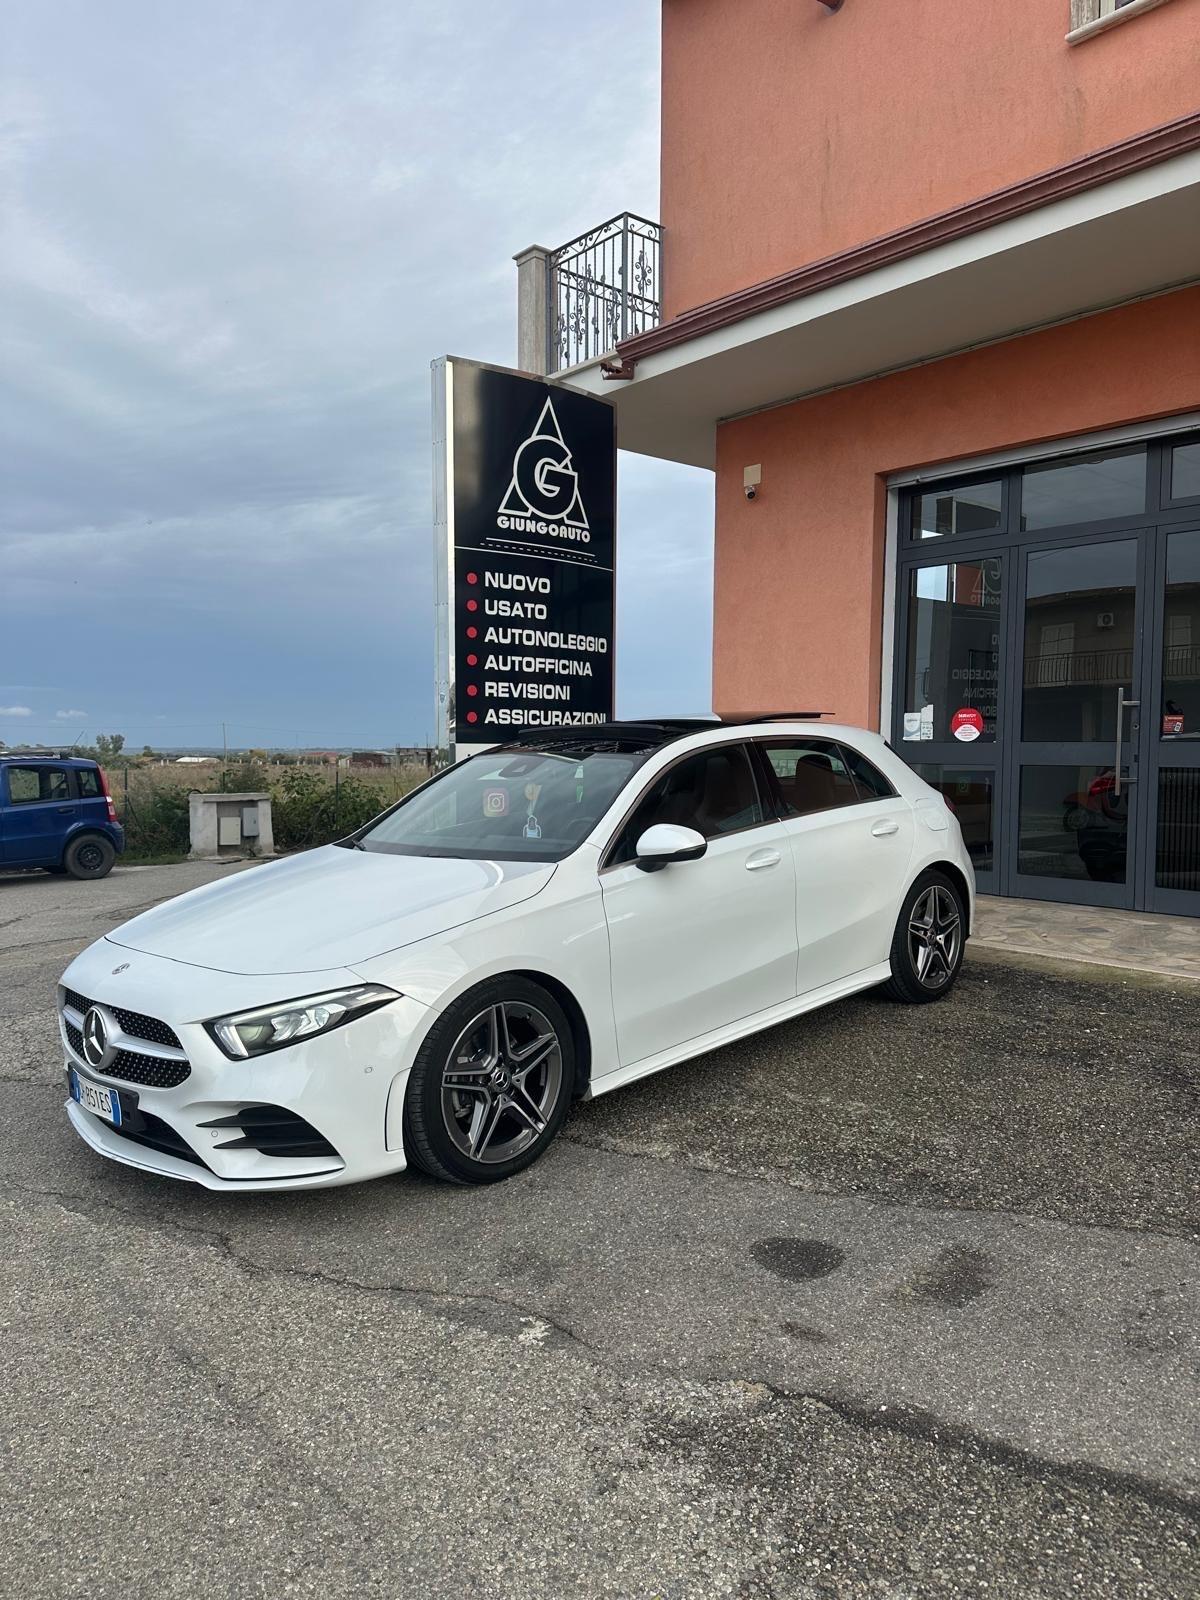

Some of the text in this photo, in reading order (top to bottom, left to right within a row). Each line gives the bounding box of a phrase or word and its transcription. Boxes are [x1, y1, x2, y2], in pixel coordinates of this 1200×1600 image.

[497, 515, 591, 543] GIUNGOAUTO
[484, 571, 550, 594] NUOVO
[484, 599, 547, 620] USATO
[484, 627, 607, 653] AUTONOLEGGIO
[484, 655, 593, 676] AUTOFFICINA
[484, 681, 570, 700] REVISIONI
[484, 708, 606, 726] ASSICURAZIONI
